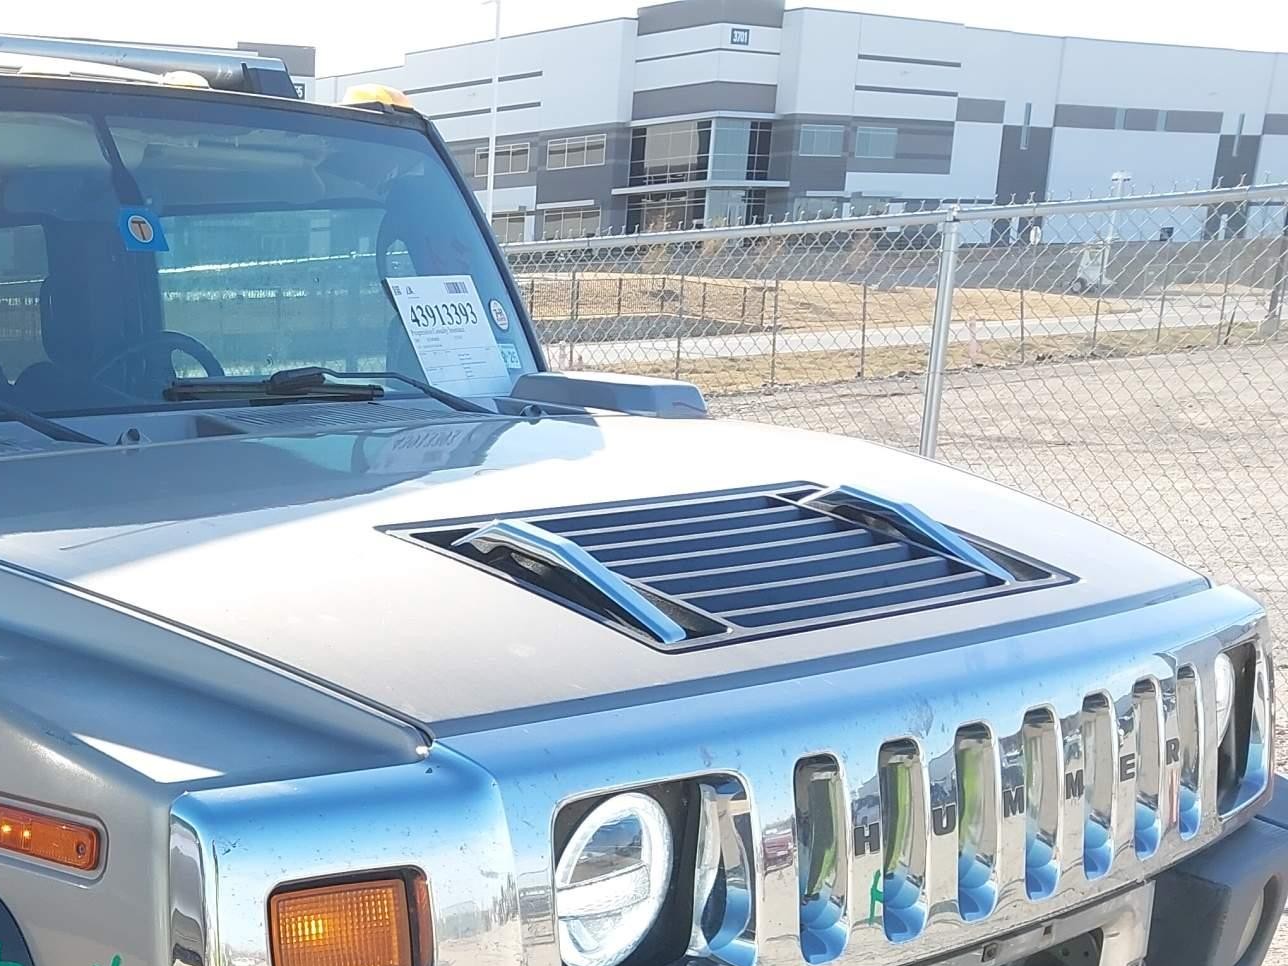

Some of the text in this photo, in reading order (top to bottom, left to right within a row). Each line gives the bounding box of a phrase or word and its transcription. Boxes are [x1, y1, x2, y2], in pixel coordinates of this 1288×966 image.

[732, 30, 749, 44] 3701
[410, 302, 478, 328] 43913393
[853, 737, 1181, 857] HUMMER
